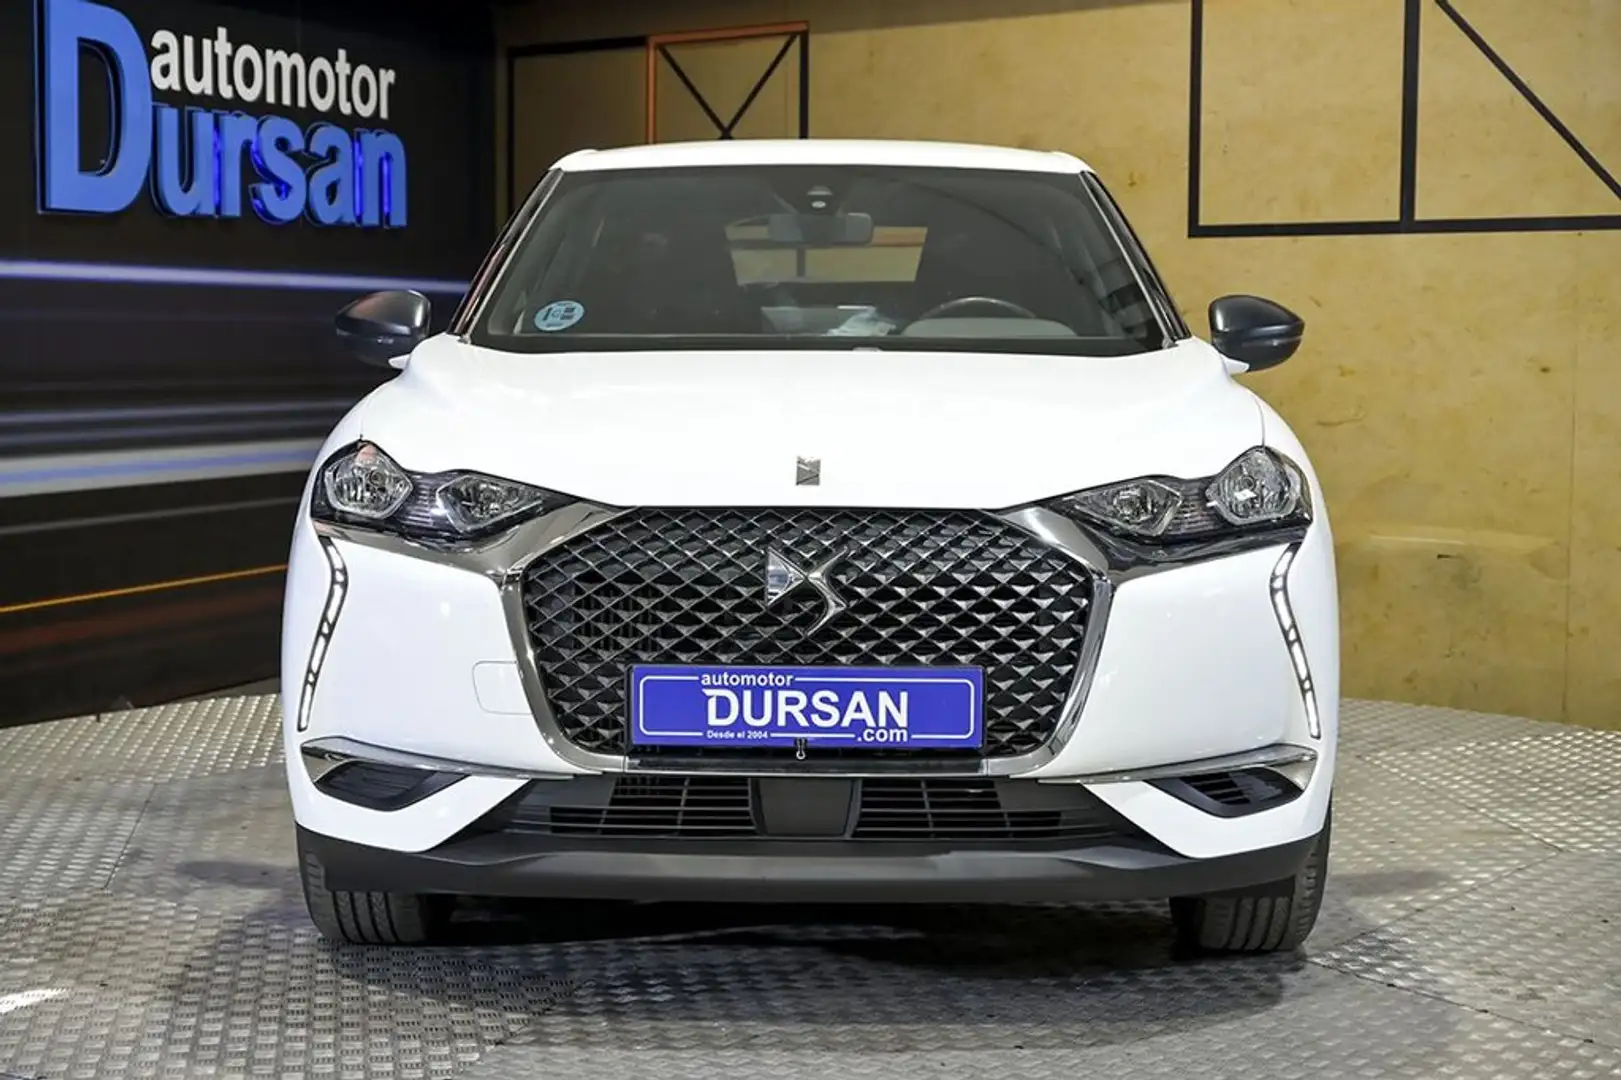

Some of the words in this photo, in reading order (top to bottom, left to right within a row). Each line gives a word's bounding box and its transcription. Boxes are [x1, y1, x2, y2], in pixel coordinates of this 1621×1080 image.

[150, 26, 396, 120] automotor
[35, 0, 407, 229] Dursan
[701, 672, 793, 687] automotor
[702, 688, 908, 728] DURSAN
[706, 730, 735, 740] Desde
[736, 730, 746, 740] el
[747, 730, 768, 740] 2004
[856, 726, 908, 743] .com
